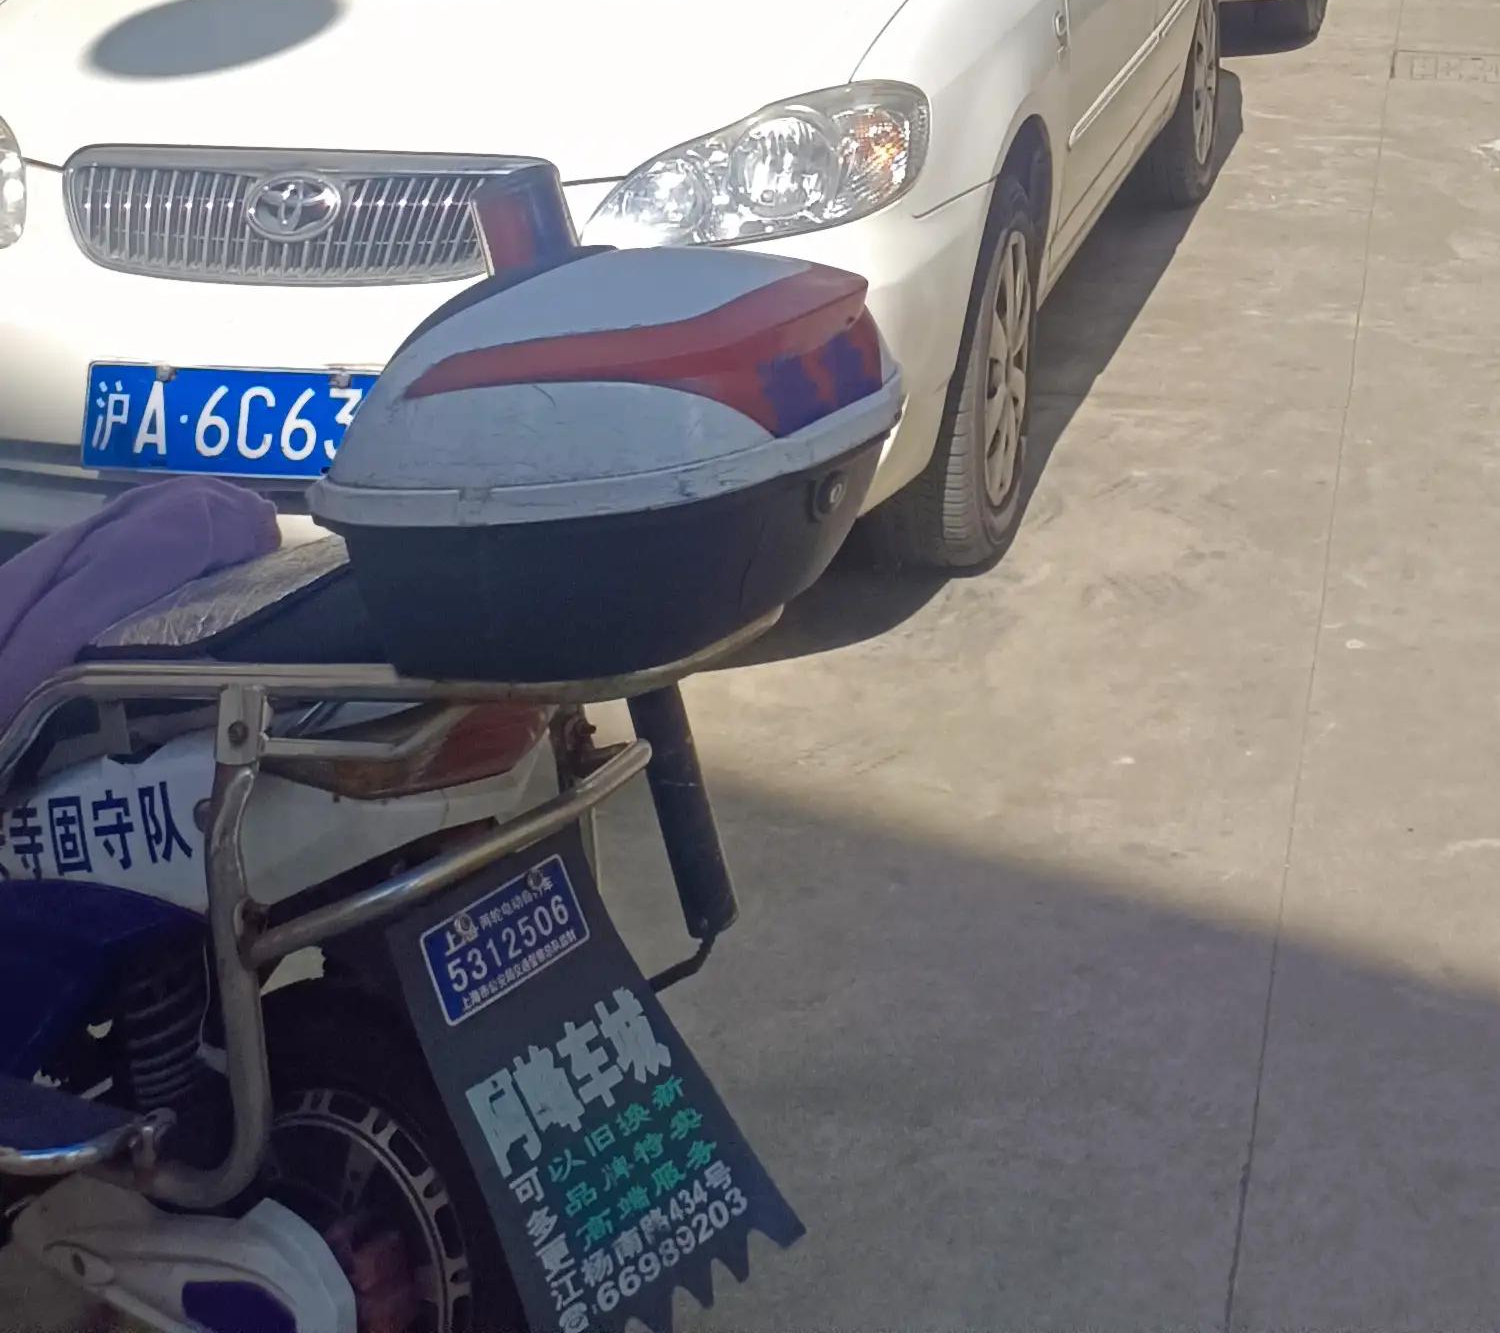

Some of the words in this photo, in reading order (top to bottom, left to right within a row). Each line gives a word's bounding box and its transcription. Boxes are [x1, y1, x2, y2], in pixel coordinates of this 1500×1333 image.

[0, 781, 193, 880] 寺固守队
[447, 895, 569, 993] 5312506
